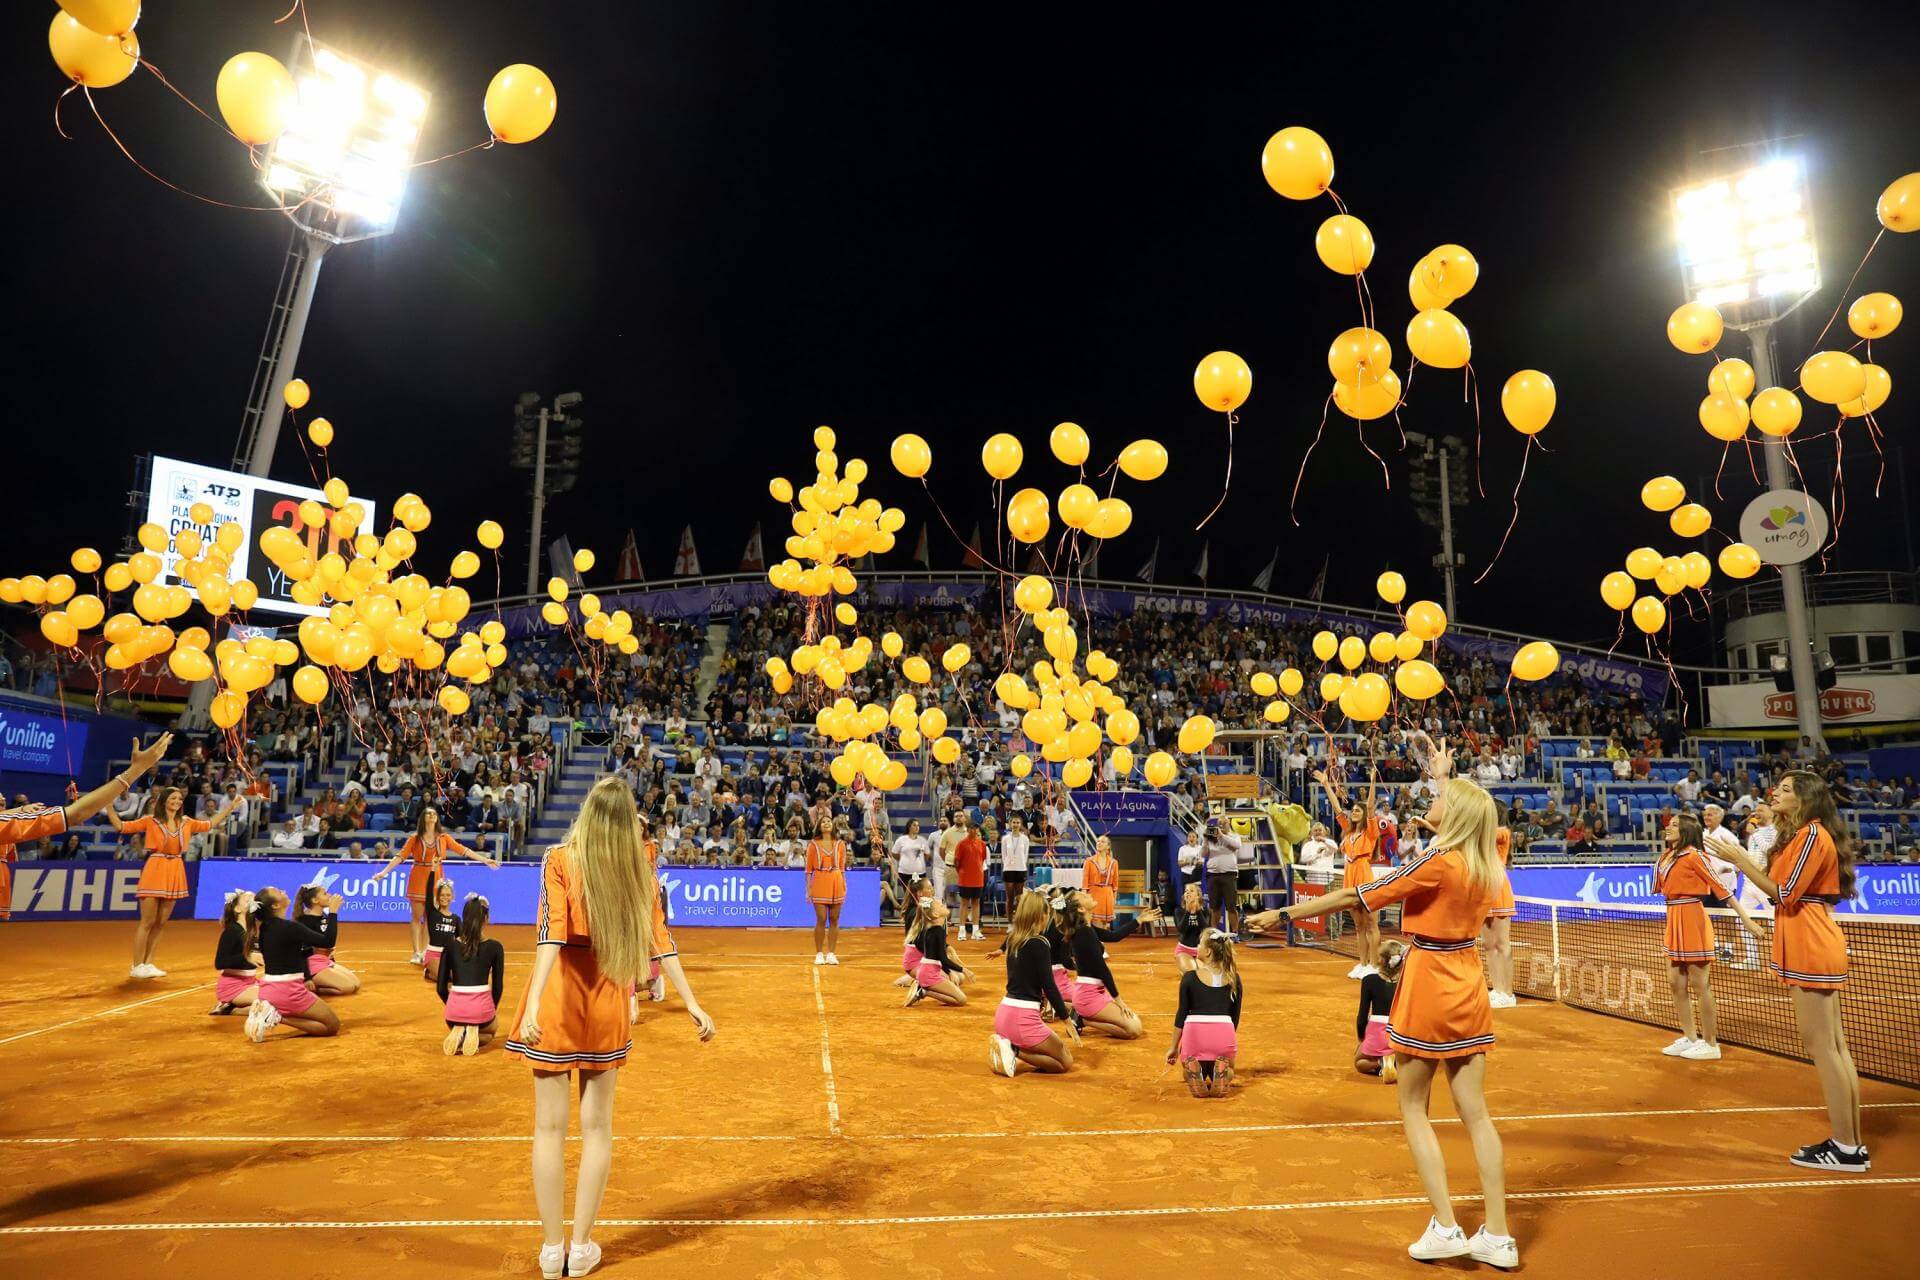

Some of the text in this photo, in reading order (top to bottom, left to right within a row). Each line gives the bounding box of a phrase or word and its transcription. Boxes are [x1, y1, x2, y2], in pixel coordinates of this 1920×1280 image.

[203, 483, 241, 498] ATP
[1765, 528, 1809, 548] umag
[1557, 657, 1643, 688] eduza
[1773, 697, 1865, 712] POAVKA
[6, 721, 56, 750] uniline
[1116, 802, 1156, 812] LAGUNA
[69, 869, 142, 911] HE
[342, 870, 407, 897] unili
[684, 876, 783, 903] uniline
[1609, 875, 1652, 898] unil
[1873, 872, 1920, 894] unili
[723, 906, 783, 918] company
